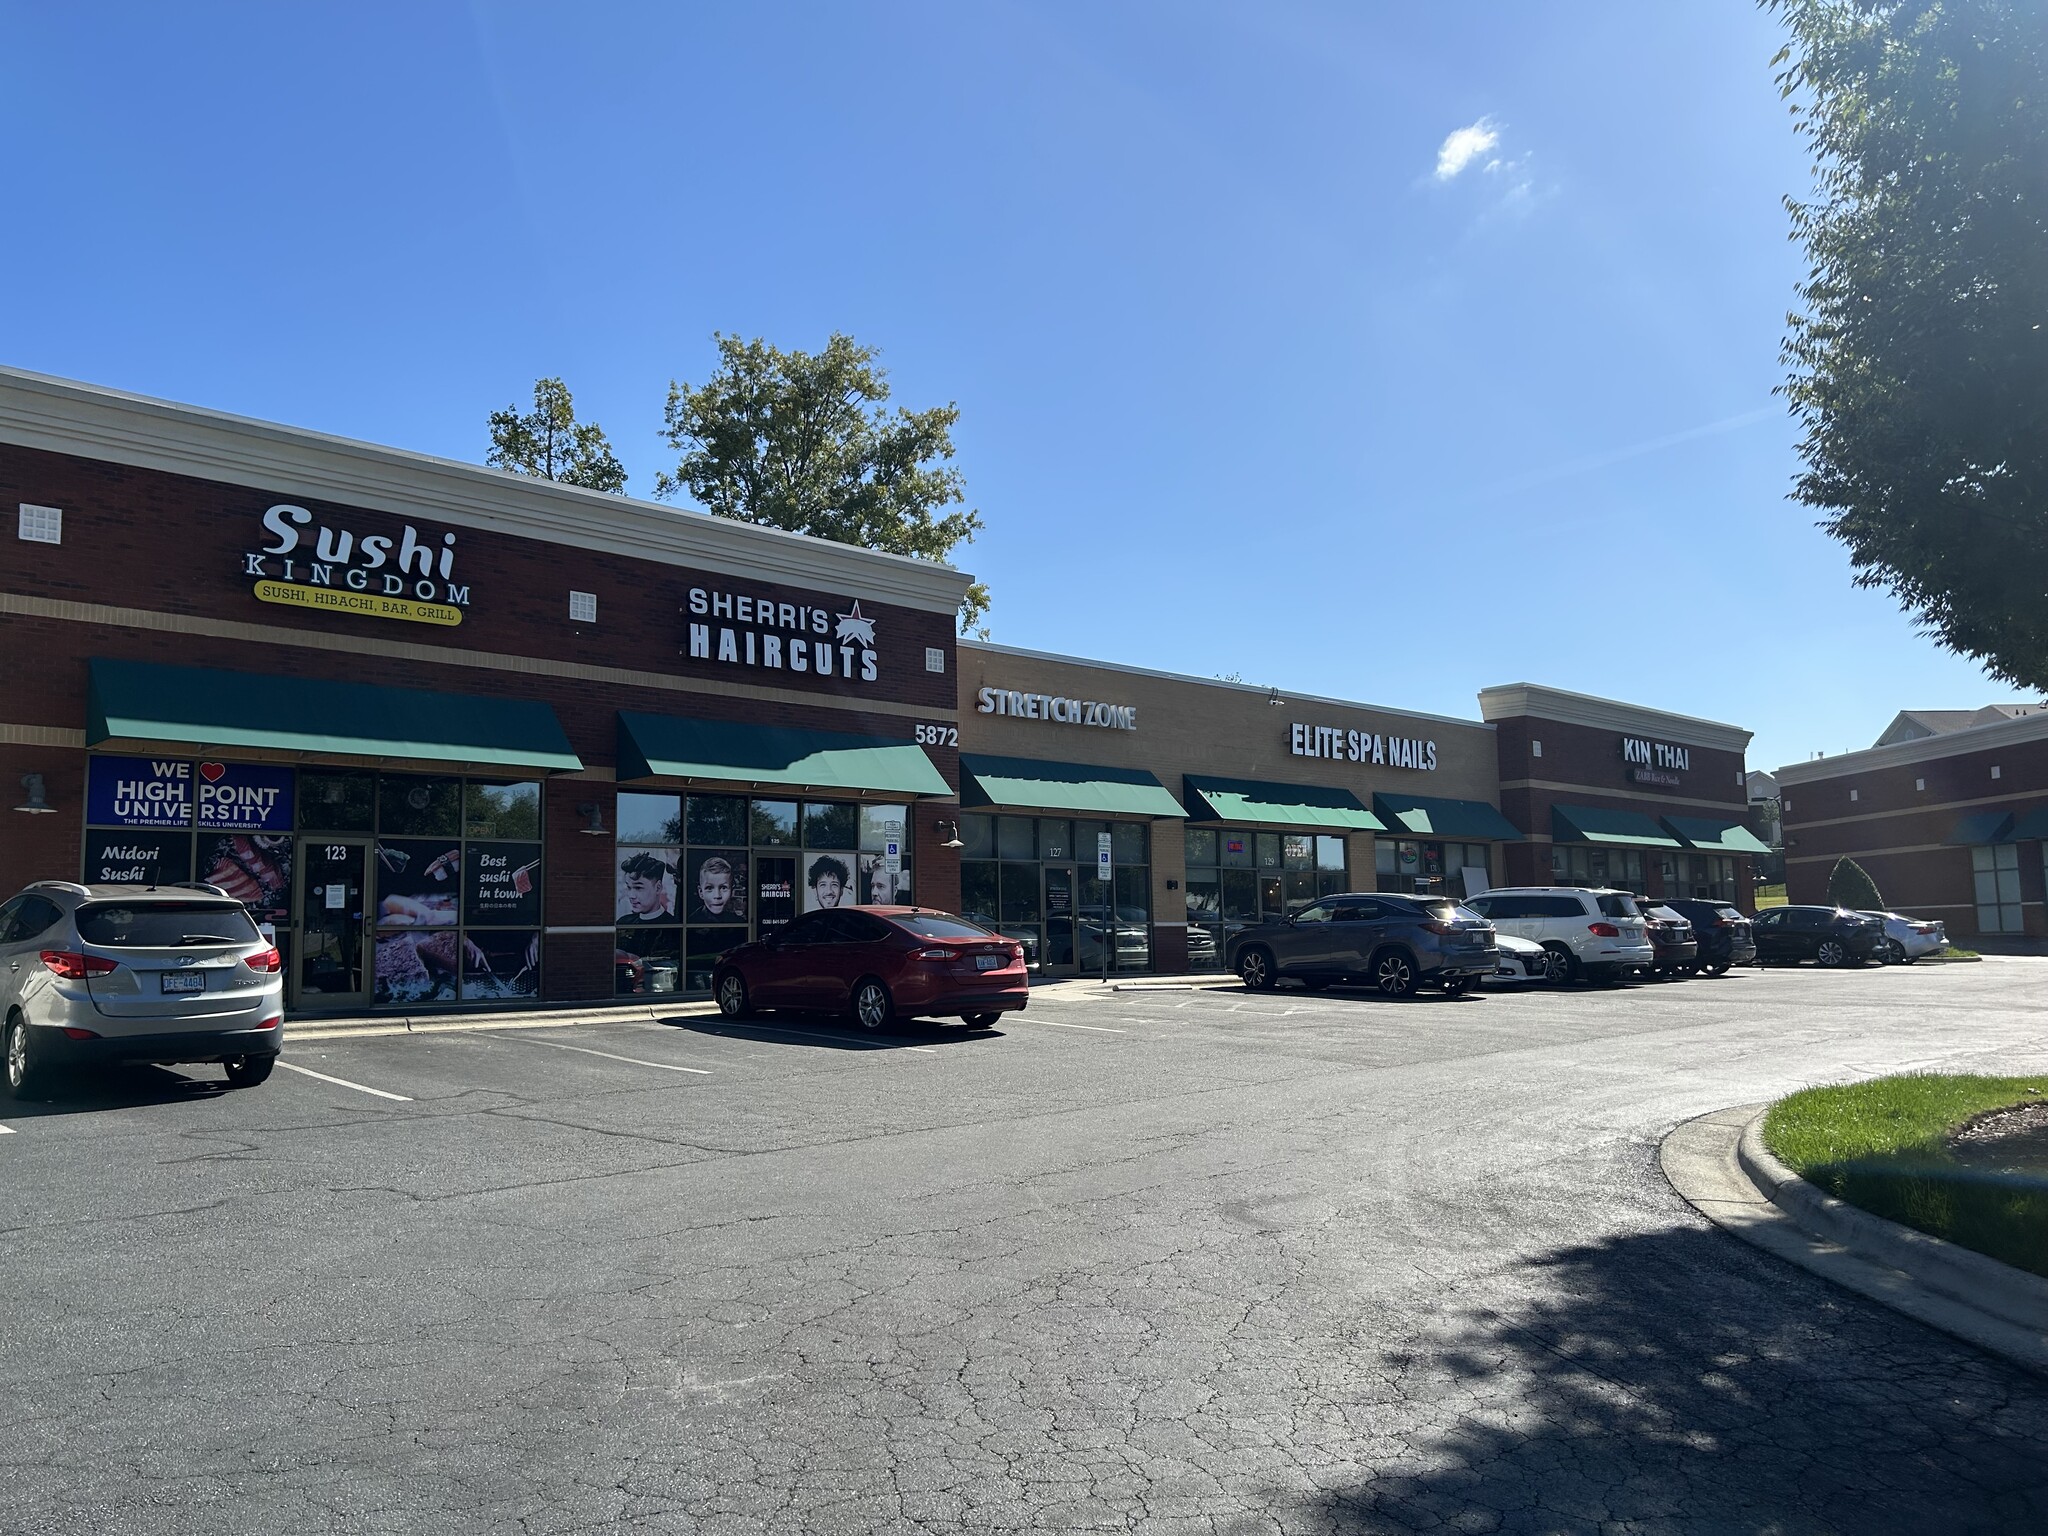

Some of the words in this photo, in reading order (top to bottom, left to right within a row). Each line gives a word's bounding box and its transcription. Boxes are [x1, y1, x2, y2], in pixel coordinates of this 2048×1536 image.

[262, 504, 456, 580] Sushi
[246, 553, 470, 605] KINGDOM
[262, 586, 310, 603] SUSHI,
[314, 592, 377, 613] HIBACHI,
[382, 601, 412, 616] BAR,
[417, 606, 454, 621] GRILL
[689, 587, 829, 634] SHERRI'S
[689, 623, 878, 682] HAIRCUTS
[978, 687, 1081, 724] STRETCH
[1083, 701, 1137, 730] ZONE
[915, 724, 959, 747] 5872
[1292, 722, 1343, 760] ELITE
[1348, 729, 1384, 765] SPA
[1389, 736, 1437, 771] NAILS
[1624, 737, 1651, 764] KIN
[1655, 743, 1689, 771] THAI
[152, 761, 190, 779] WE
[116, 780, 185, 802] HIGH
[199, 784, 280, 807] POINT
[114, 800, 271, 822] UNIVERSITY
[139, 818, 172, 826] PREMIER
[101, 846, 160, 860] Midori
[325, 845, 347, 861] 123
[480, 854, 507, 867] Best
[1050, 848, 1061, 857] 127
[1264, 857, 1275, 866] 129
[100, 866, 146, 881] Sushi
[479, 870, 511, 883] sushi
[479, 887, 491, 898] in
[494, 888, 523, 899] town
[761, 890, 791, 898] HAIRCUTS
